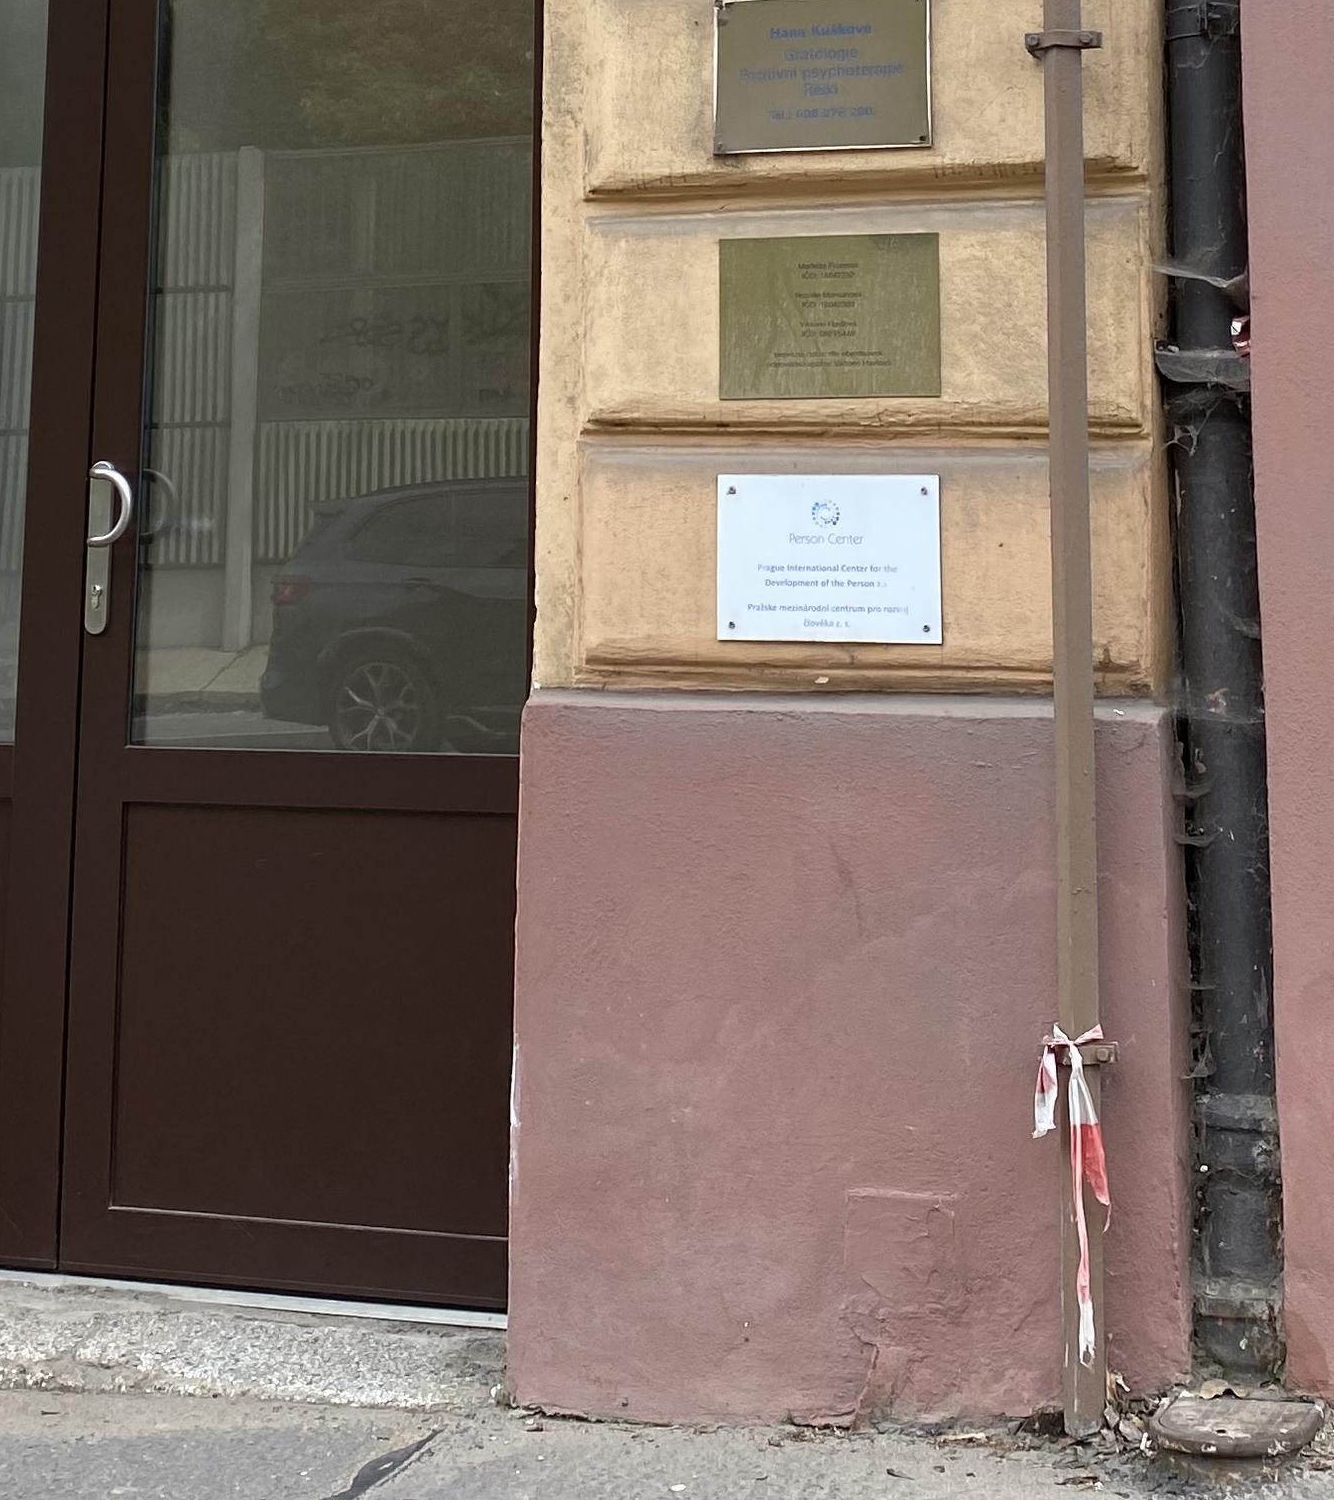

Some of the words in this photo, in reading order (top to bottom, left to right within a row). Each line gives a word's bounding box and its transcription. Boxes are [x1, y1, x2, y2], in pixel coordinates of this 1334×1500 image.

[788, 533, 825, 545] Person
[827, 533, 864, 545] Center
[757, 564, 785, 574] Prague
[787, 564, 839, 573] International
[841, 564, 868, 573] Center
[869, 564, 882, 573] for
[765, 578, 818, 589] Development
[821, 578, 831, 587] of
[831, 579, 845, 587] the
[847, 579, 875, 588] Person
[831, 605, 866, 613] centrum
[867, 606, 882, 614] pro
